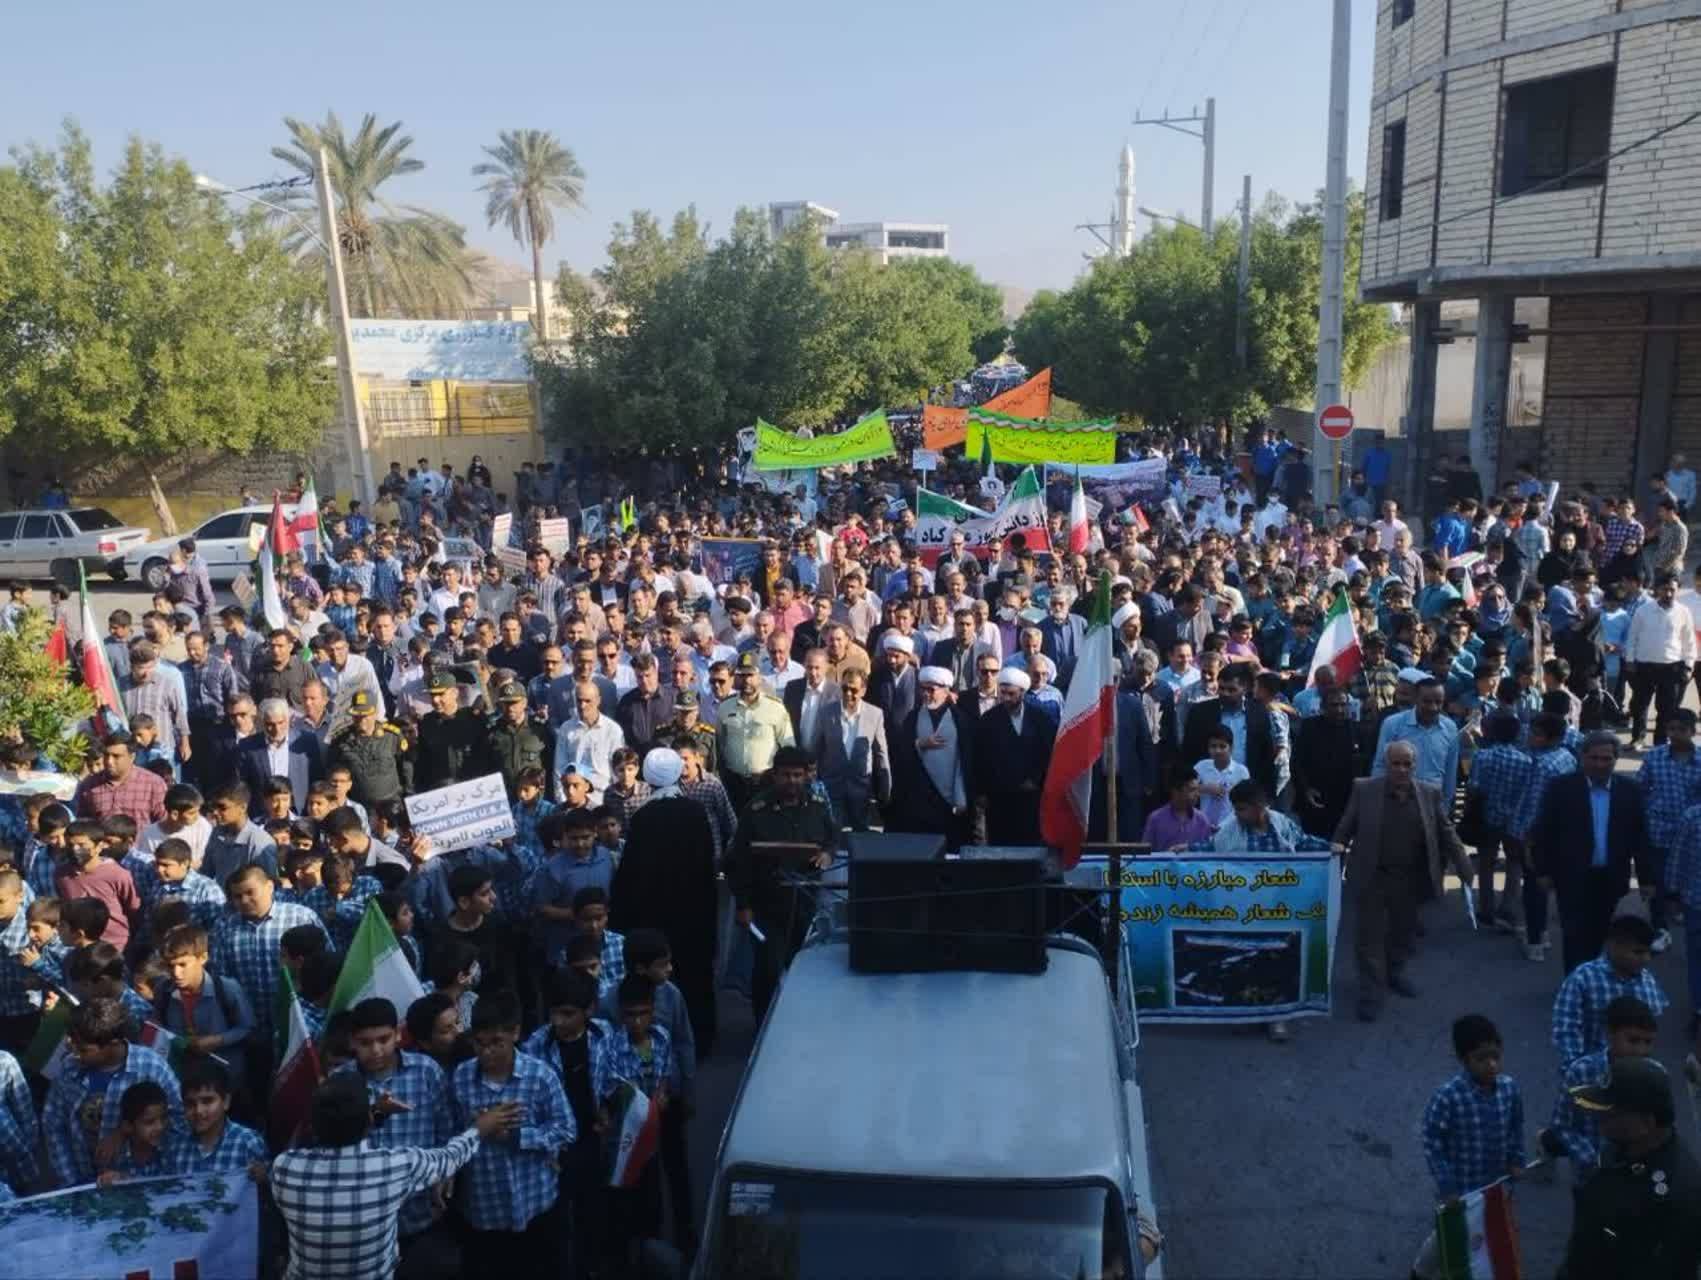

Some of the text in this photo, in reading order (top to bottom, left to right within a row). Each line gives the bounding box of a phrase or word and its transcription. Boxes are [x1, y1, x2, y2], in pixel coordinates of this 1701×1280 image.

[456, 792, 467, 808] بر
[471, 782, 502, 800] مرگ
[1163, 868, 1178, 890] با
[1183, 868, 1247, 893] مبارزه
[1249, 868, 1300, 892] شعار
[1168, 901, 1239, 925] همیشه
[1241, 902, 1292, 925] شعار
